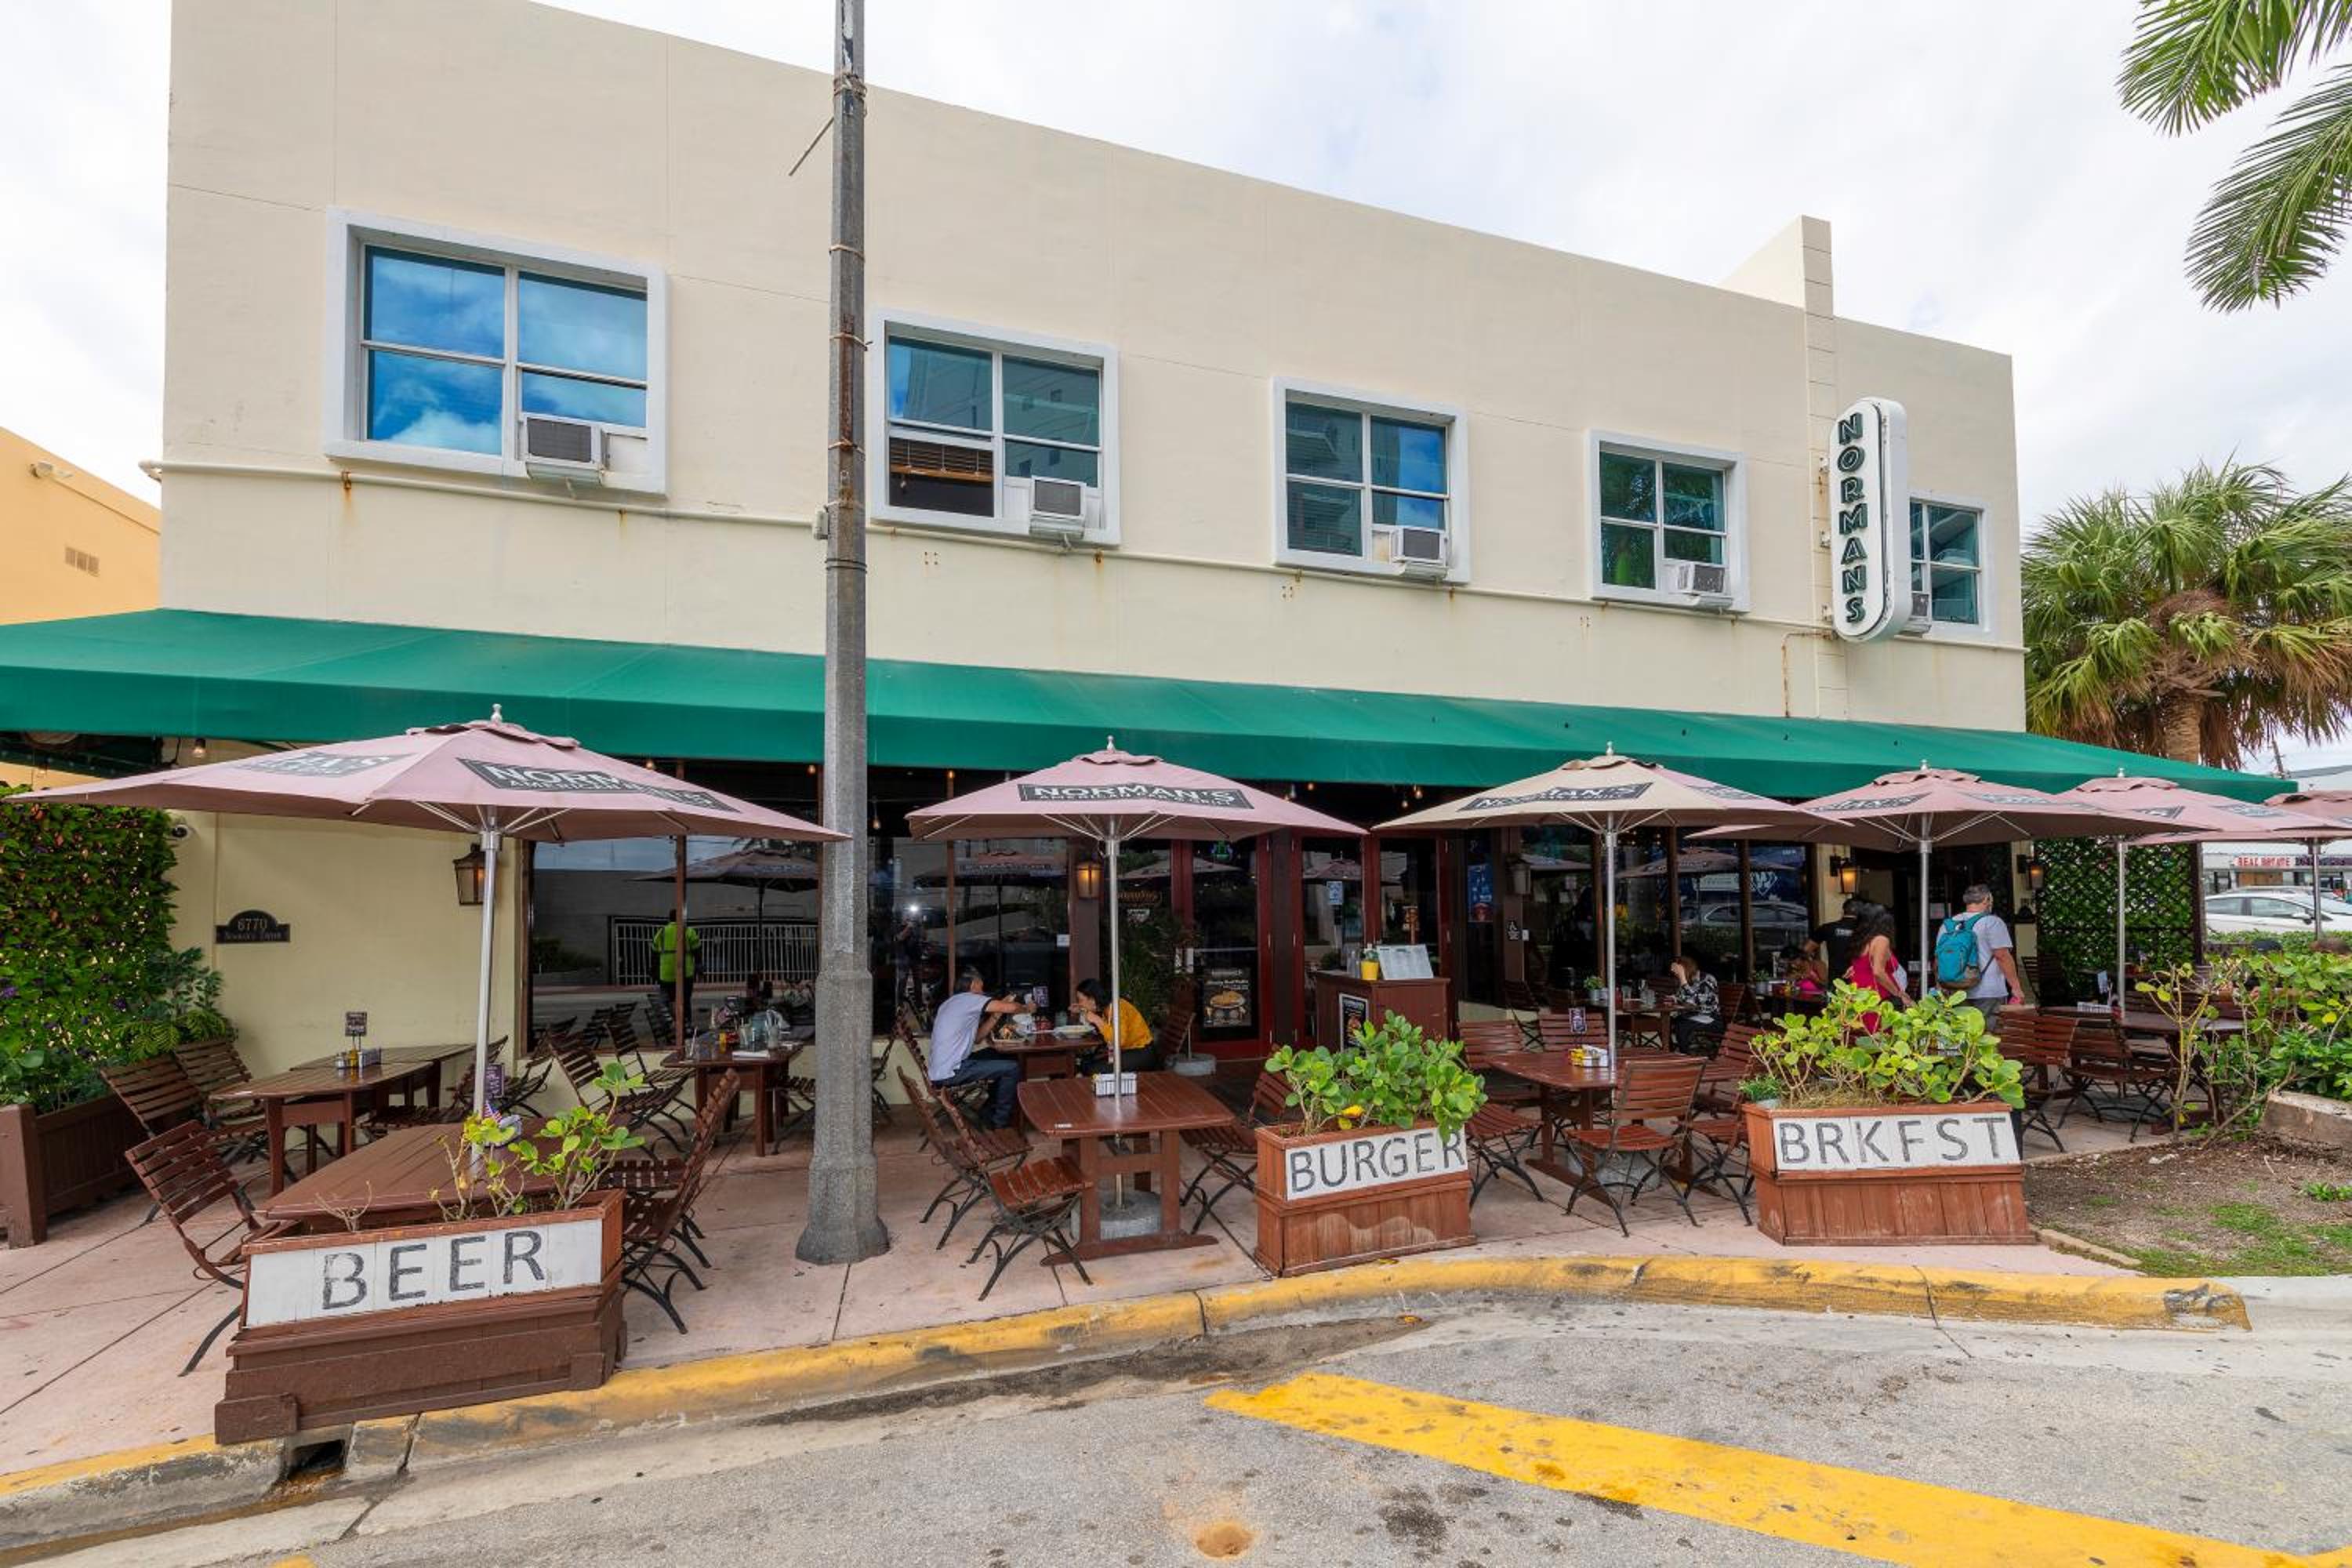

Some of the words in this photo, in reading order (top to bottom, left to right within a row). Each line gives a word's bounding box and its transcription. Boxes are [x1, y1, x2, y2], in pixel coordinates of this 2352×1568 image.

[1837, 412, 1868, 623] NORMANS
[1034, 785, 1235, 802] NORMAN'S
[1290, 1130, 1465, 1192] BURGER
[1779, 1116, 2007, 1164] BRKFST
[321, 1229, 546, 1310] BEER
